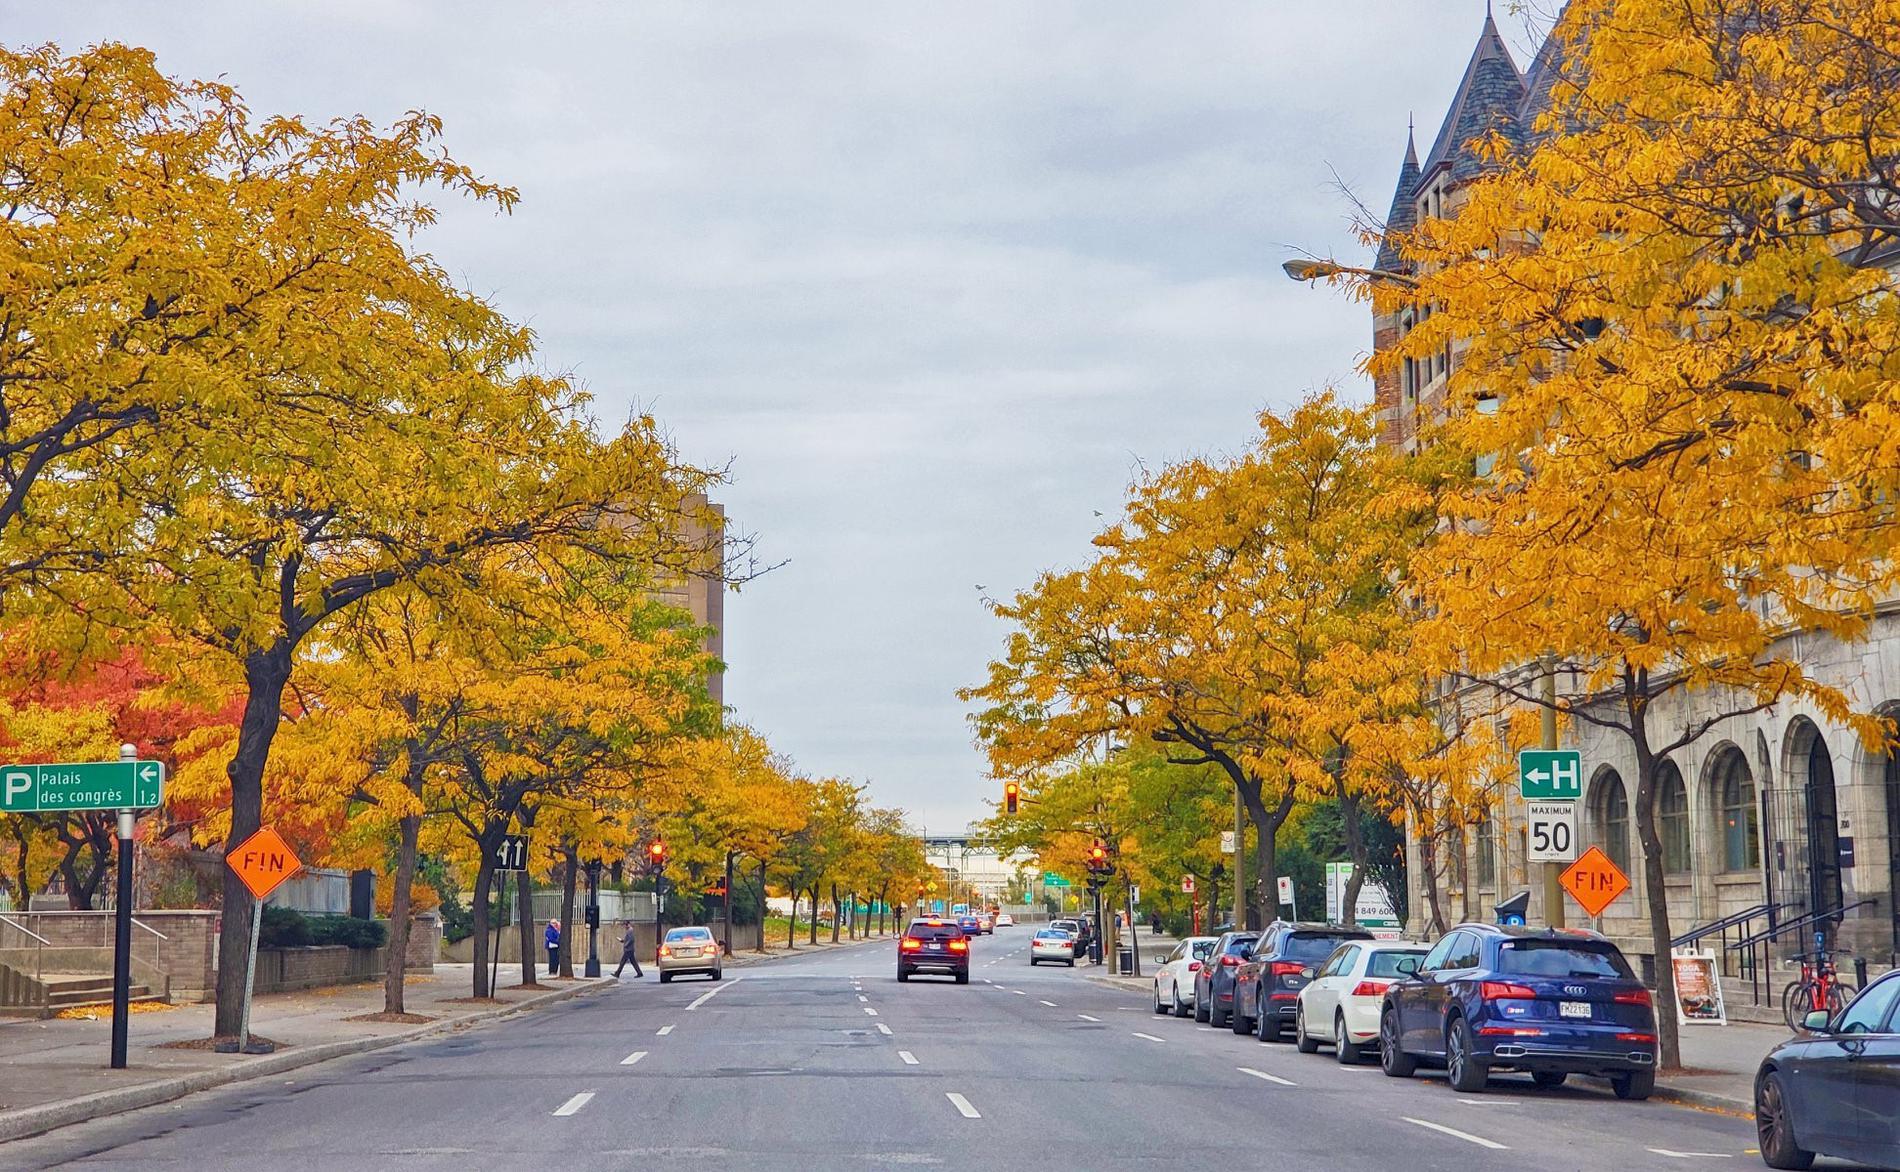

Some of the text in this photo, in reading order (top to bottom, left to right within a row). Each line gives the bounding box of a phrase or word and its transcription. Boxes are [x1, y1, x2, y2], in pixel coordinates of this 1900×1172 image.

[41, 771, 81, 785] Palais
[1552, 760, 1578, 790] H
[5, 772, 32, 805] P
[41, 788, 122, 805] des congrès
[1531, 806, 1572, 815] MAXIMUM
[1533, 821, 1570, 852] 50
[243, 852, 284, 873] FIN
[1575, 871, 1613, 891] FIN
[1361, 907, 1376, 915] 849
